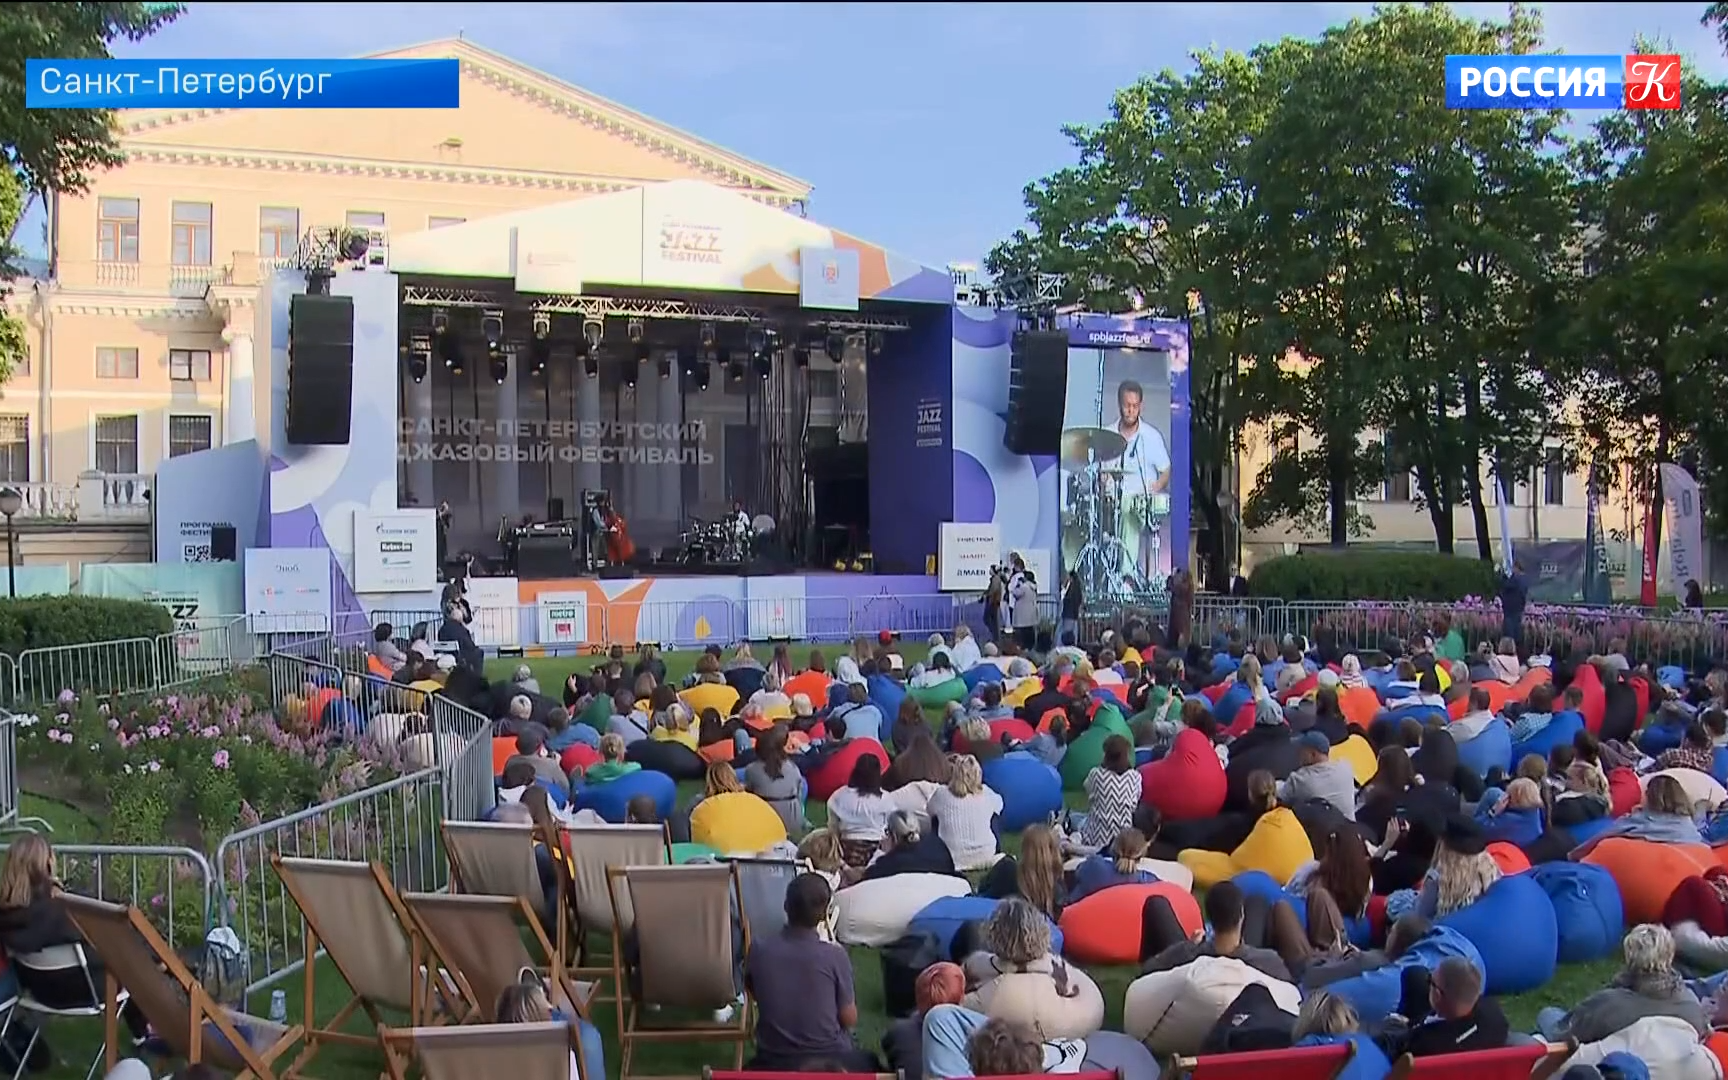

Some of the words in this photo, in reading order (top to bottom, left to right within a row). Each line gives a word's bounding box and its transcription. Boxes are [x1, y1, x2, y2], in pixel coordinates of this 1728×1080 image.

[918, 408, 942, 424] JAZZ
[398, 417, 707, 440] САНКТ-ПЕТЕРБУРГСКИЙ
[397, 441, 553, 464] ДЖАЗОВЫЙ
[559, 444, 714, 465] ФЕСТИВАЛЬ
